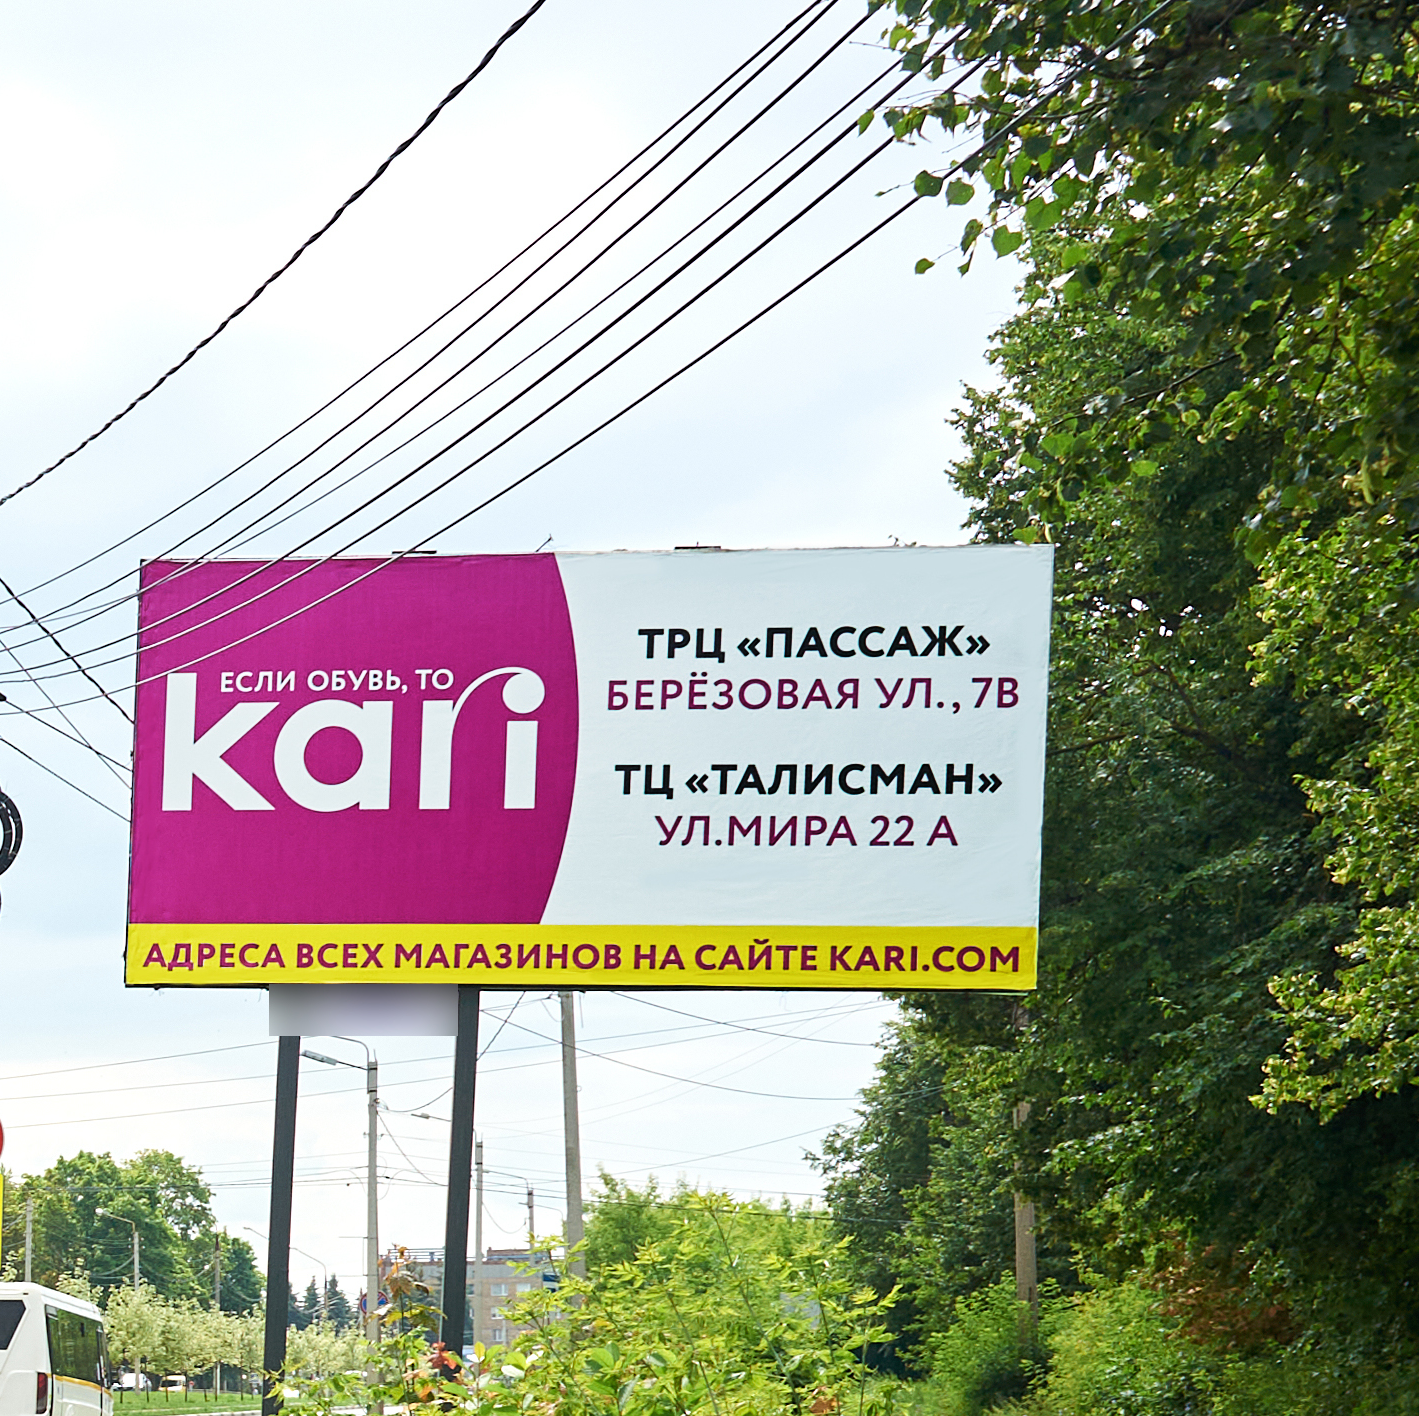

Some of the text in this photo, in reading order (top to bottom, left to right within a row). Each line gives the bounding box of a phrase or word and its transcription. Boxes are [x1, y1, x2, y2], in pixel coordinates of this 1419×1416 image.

[637, 625, 991, 664] ТРЦ «ПАССАЖ»
[219, 668, 455, 695] ЕСЛИ ОБУВЬ, ТО
[607, 671, 1020, 715] БЕРЁЗОВАЯ УЛ., 7В
[161, 666, 546, 813] kari
[614, 763, 1003, 800] ТЦ «ТАЛИСМАН»
[654, 815, 959, 847] УЛ.МИРА 22 А
[142, 938, 1021, 973] АДРЕСА ВСЕХ МАГАЗИНОВ НА САЙТЕ KARI.COM
